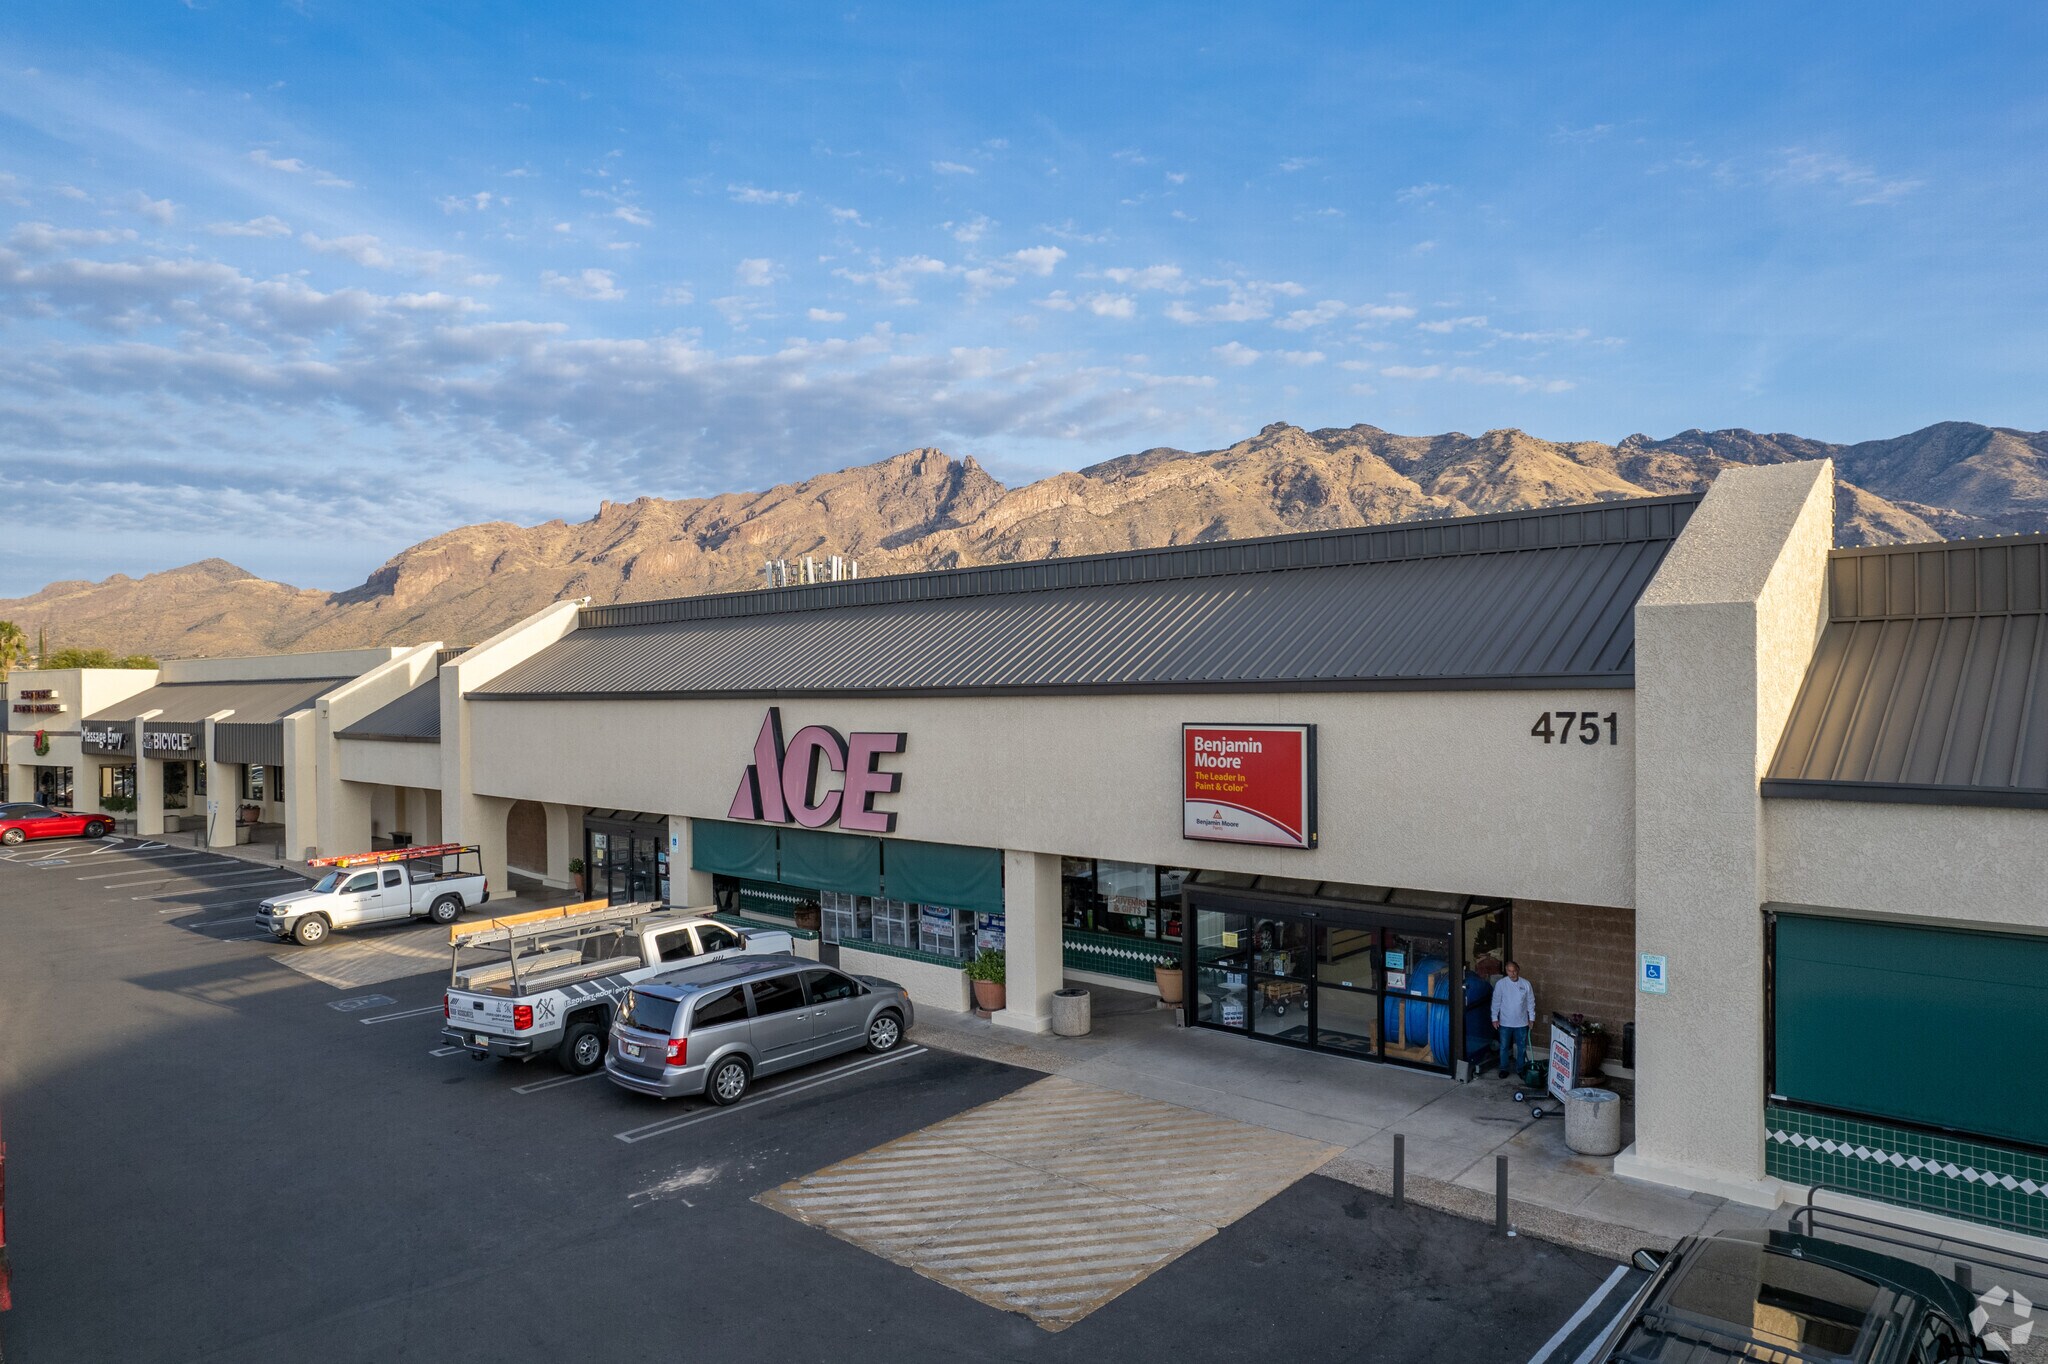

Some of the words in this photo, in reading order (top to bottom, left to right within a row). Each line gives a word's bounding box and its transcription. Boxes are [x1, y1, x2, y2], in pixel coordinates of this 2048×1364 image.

[1531, 711, 1617, 746] 4751
[81, 726, 106, 748] Massage
[107, 726, 123, 750] Envy
[153, 732, 190, 751] BICYCLE
[1194, 736, 1263, 756] Benjamin
[1194, 752, 1242, 769] Moore
[728, 707, 907, 832] ACE
[1195, 771, 1209, 780] The
[1210, 772, 1237, 782] Leader
[1237, 773, 1246, 782] In
[1195, 781, 1215, 791] Paint
[1215, 782, 1222, 791] &
[1196, 818, 1221, 826] Benjamin
[1221, 820, 1239, 828] Moore
[1110, 897, 1147, 908] OUVENIRS
[1121, 906, 1142, 914] GIFTS
[1552, 1078, 1568, 1095] AmeriGa
